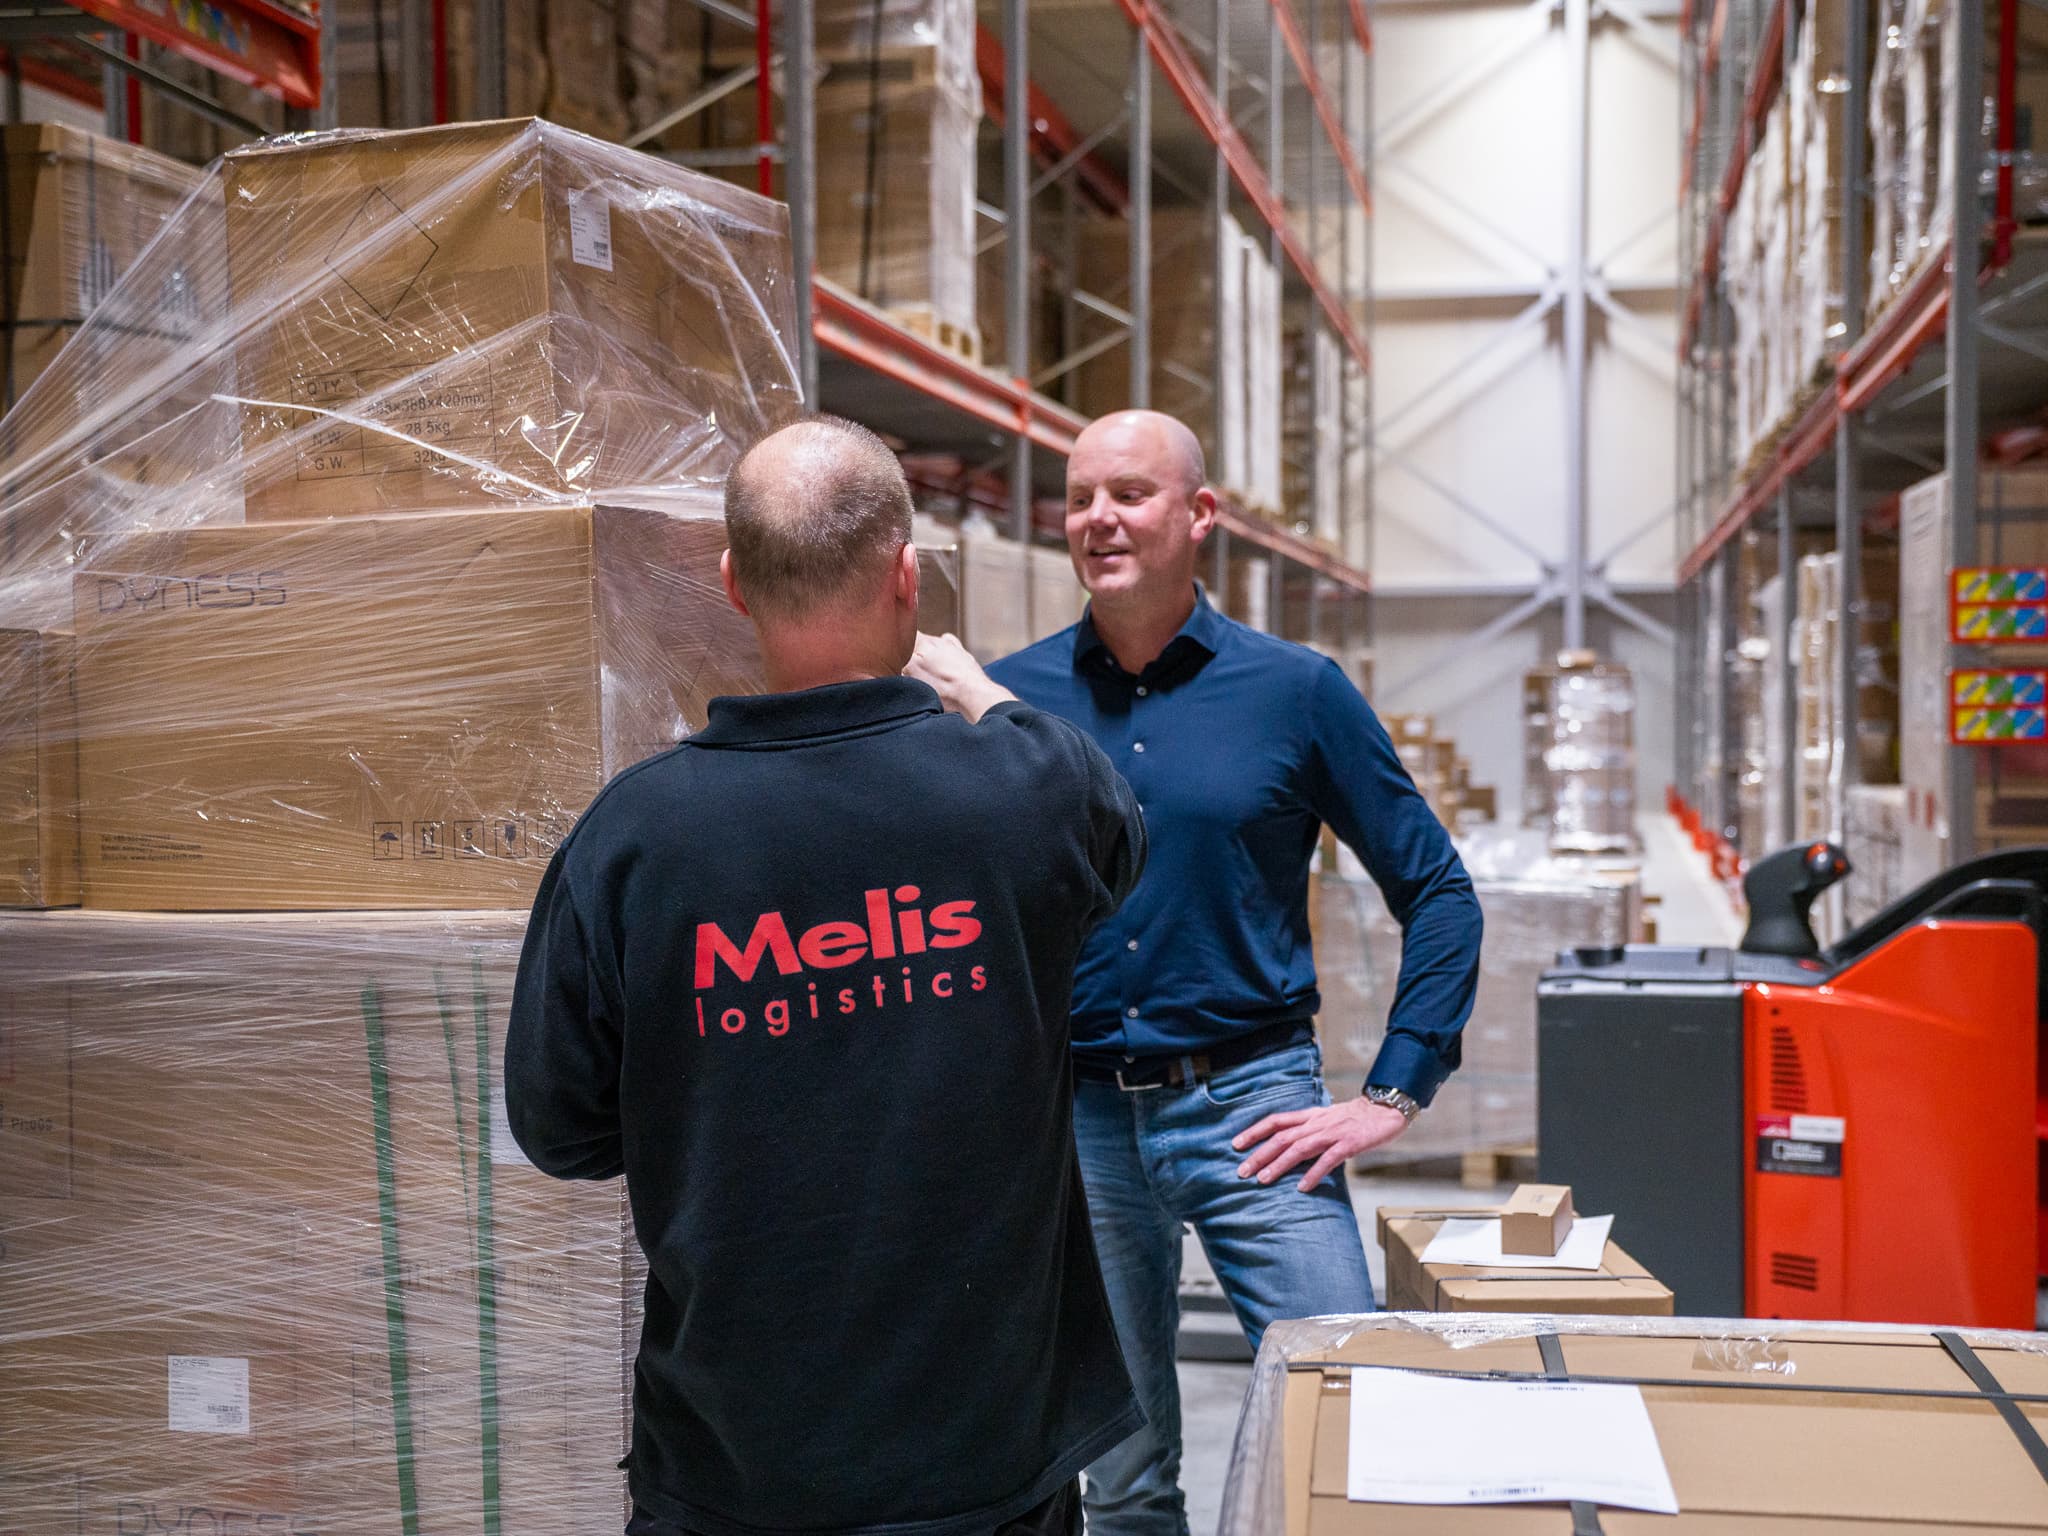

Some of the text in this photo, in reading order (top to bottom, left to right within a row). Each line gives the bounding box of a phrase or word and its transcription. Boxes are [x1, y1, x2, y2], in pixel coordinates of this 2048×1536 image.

[314, 456, 346, 471] G.W.
[694, 884, 983, 990] Melis
[695, 966, 987, 1038] logistics
